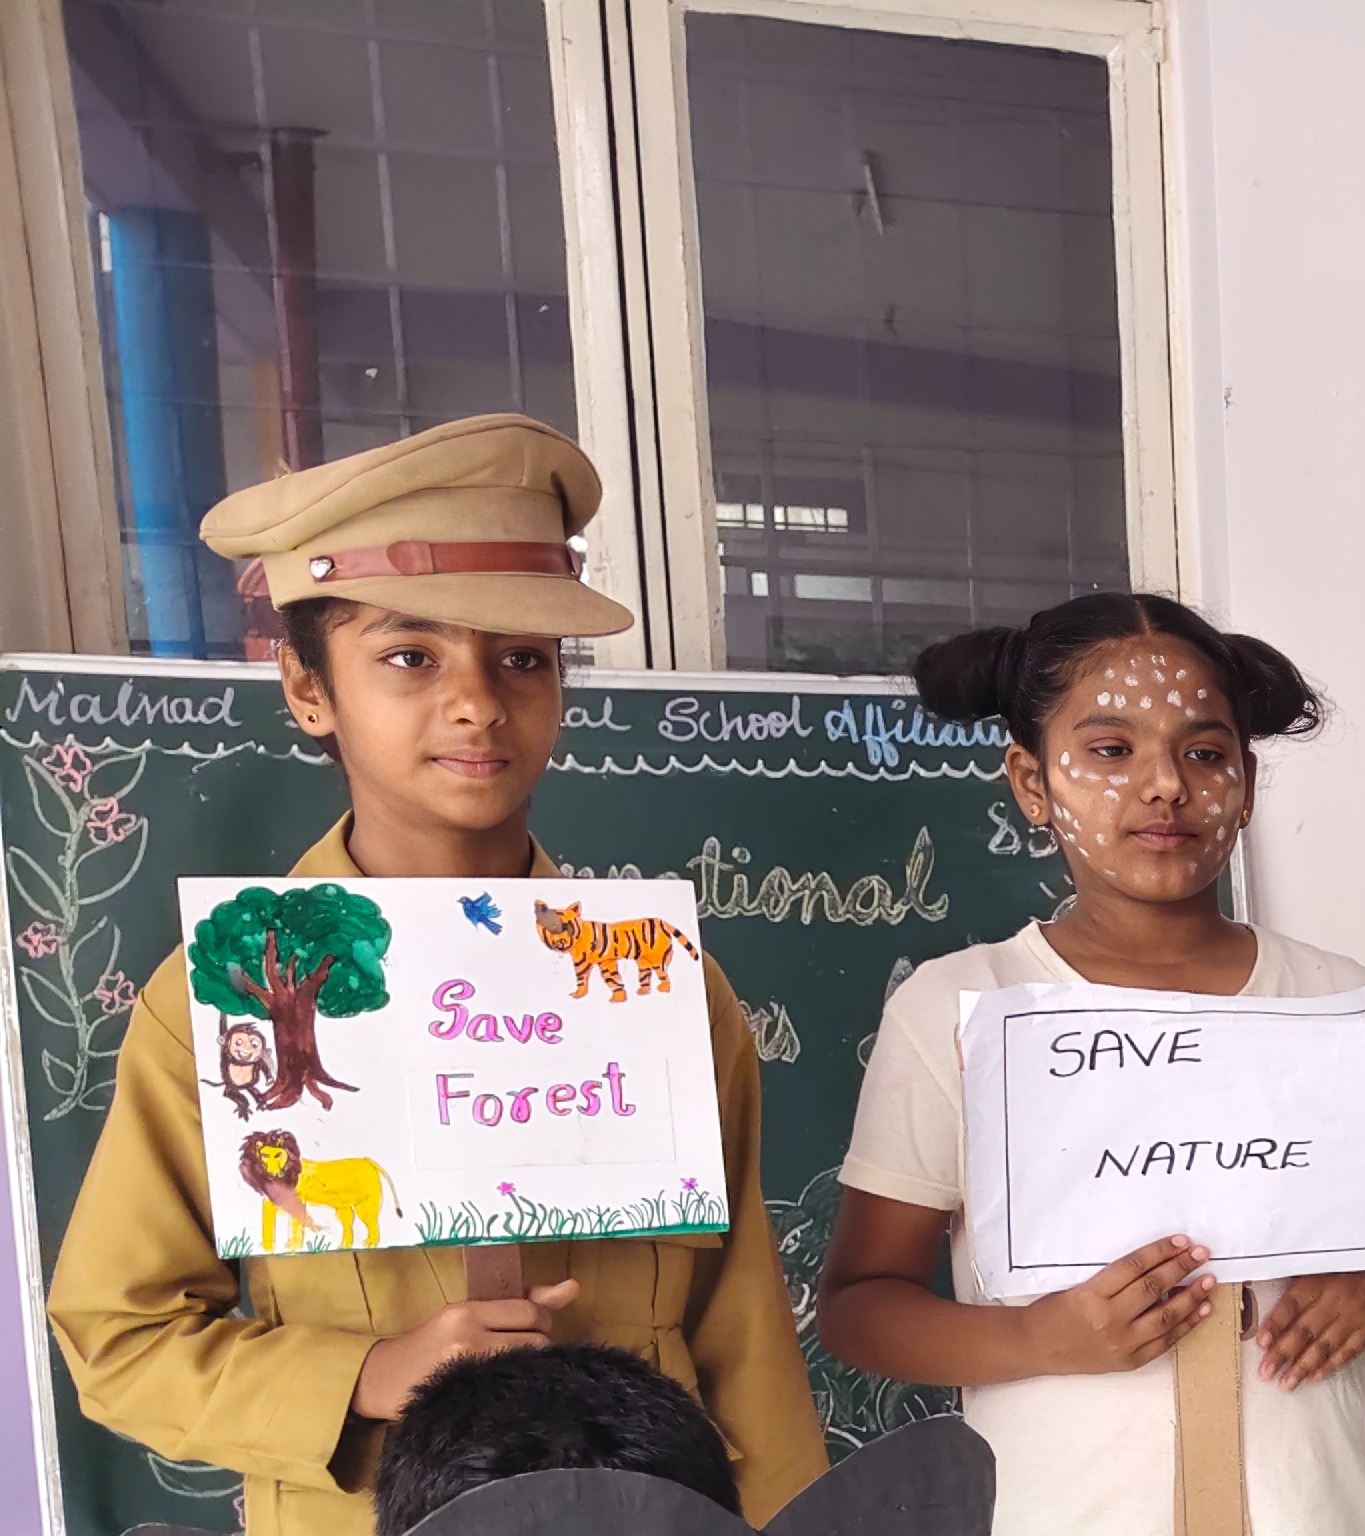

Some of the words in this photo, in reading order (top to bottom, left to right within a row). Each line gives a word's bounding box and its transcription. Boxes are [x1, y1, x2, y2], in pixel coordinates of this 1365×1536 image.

[6, 675, 243, 727] Malnad
[660, 694, 812, 742] School
[428, 979, 564, 1045] Save
[1049, 1028, 1203, 1078] SAVE
[435, 1061, 636, 1127] Forest
[1094, 1137, 1313, 1179] NATURE
